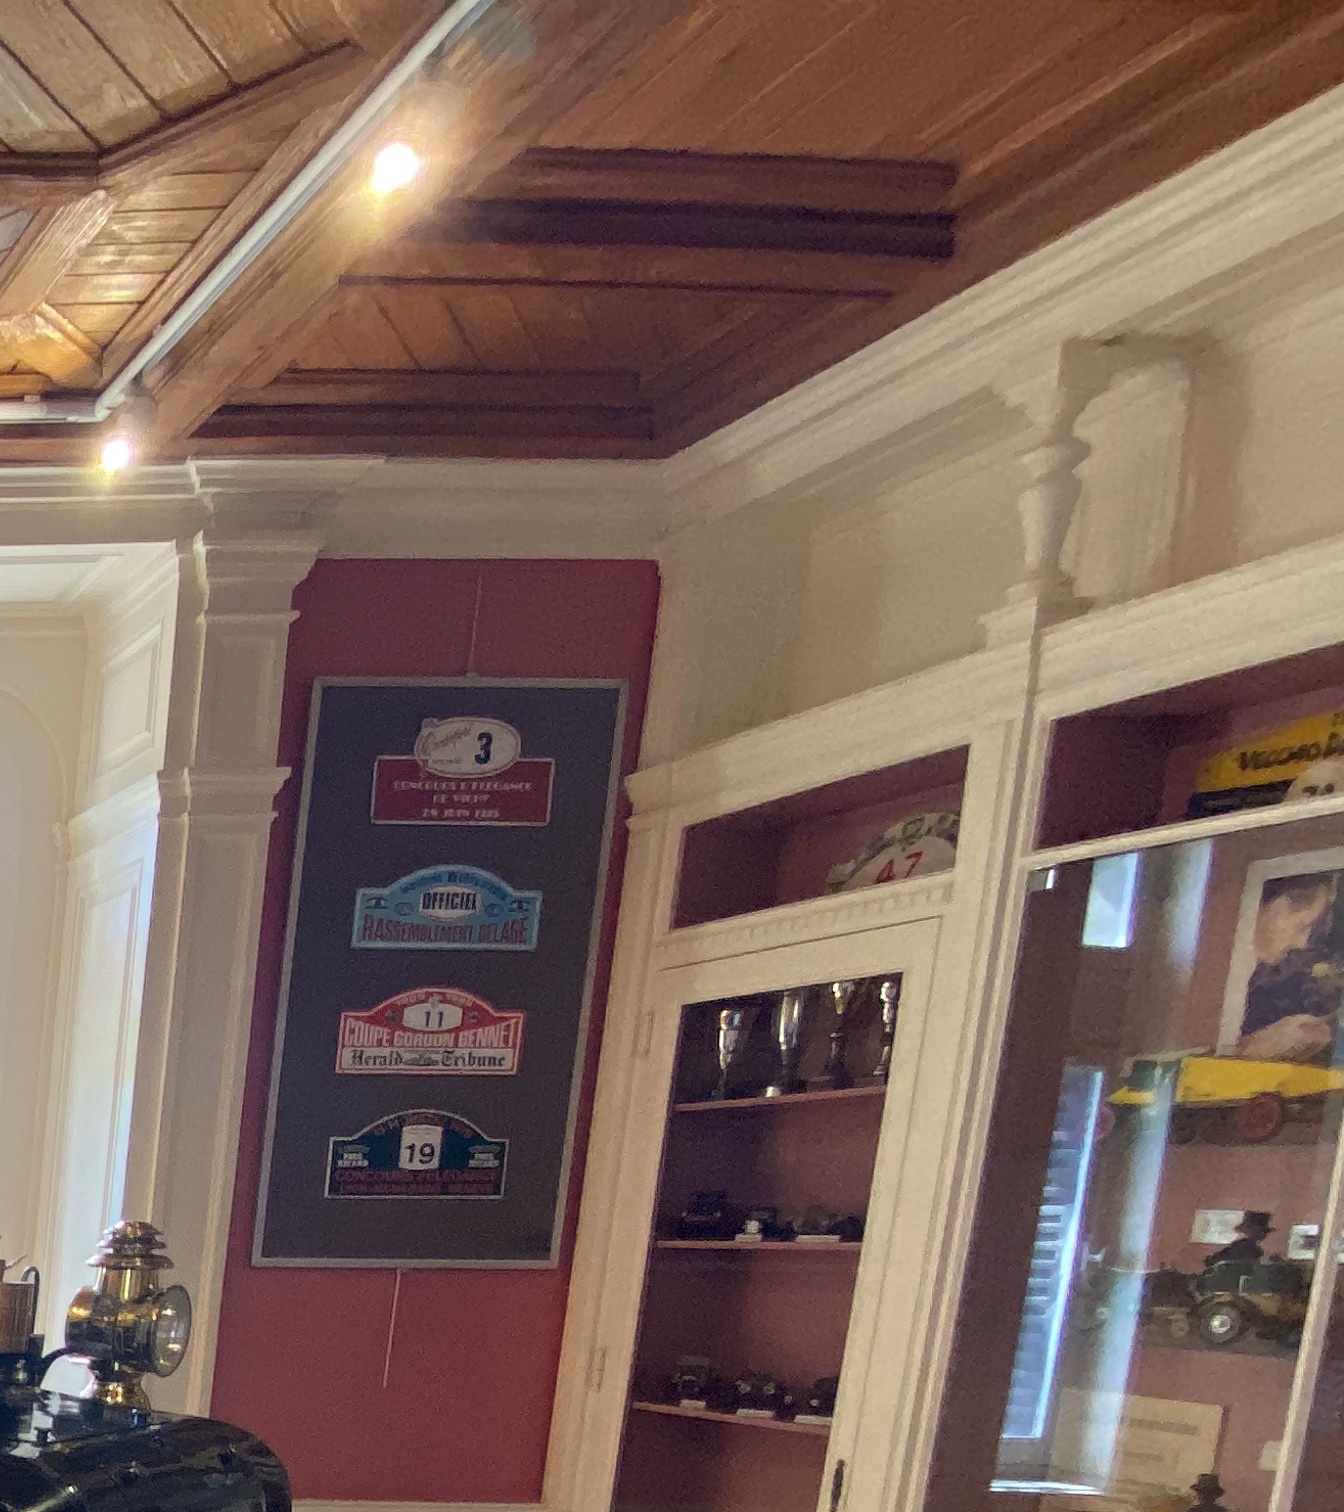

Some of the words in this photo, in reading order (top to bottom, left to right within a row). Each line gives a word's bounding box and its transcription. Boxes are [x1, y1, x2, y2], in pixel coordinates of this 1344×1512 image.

[474, 732, 493, 765] 3
[424, 1011, 444, 1029] 11
[344, 1017, 391, 1047] COUPE
[393, 1030, 456, 1047] GORDON
[350, 1050, 404, 1067] Herald
[440, 1049, 507, 1067] Tribune
[404, 1142, 435, 1165] 19
